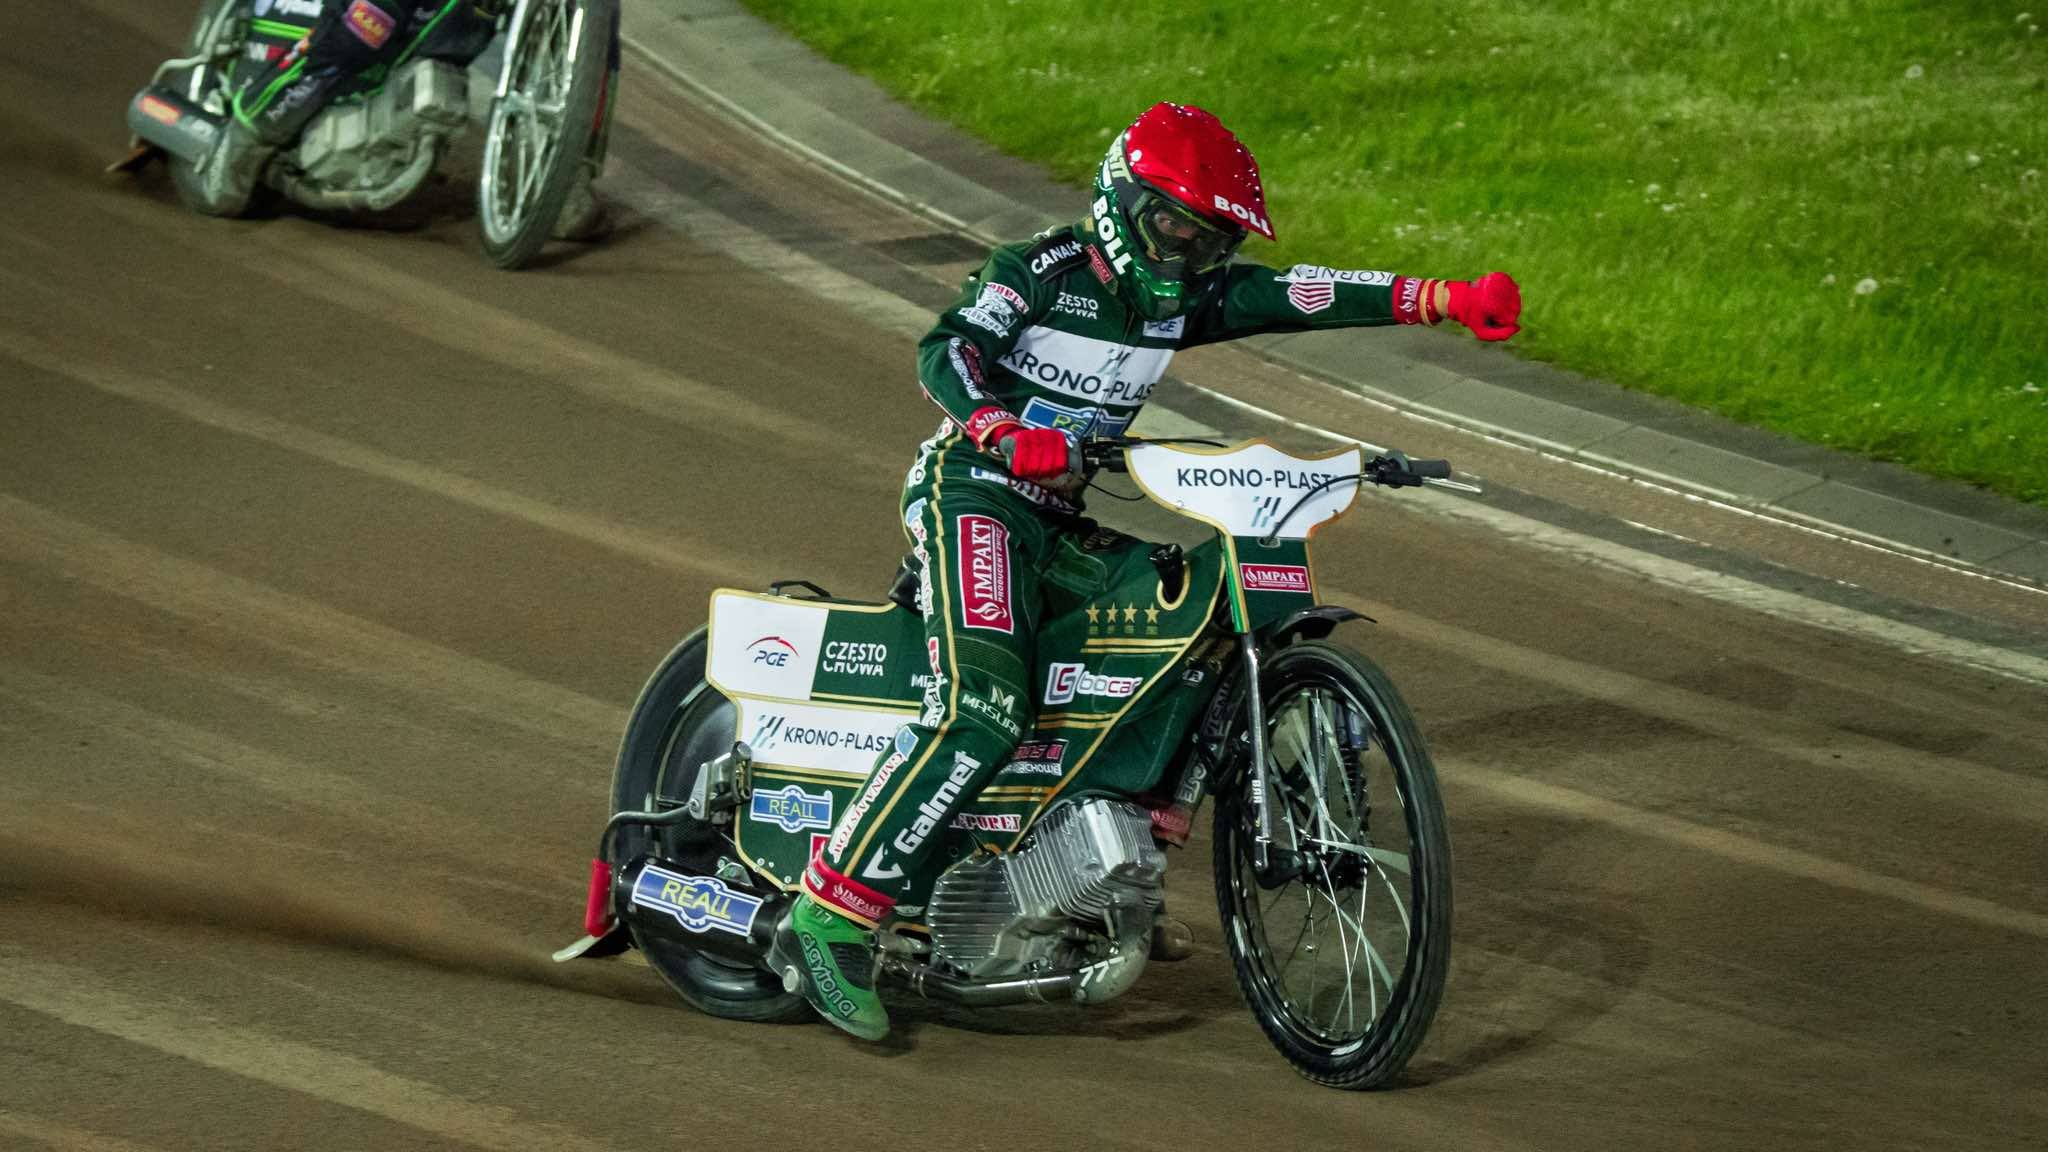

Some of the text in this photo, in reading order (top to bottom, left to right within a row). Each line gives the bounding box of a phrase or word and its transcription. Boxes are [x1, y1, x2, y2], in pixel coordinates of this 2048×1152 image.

[1214, 194, 1272, 236] BOLL
[1093, 195, 1133, 275] BOLL
[1031, 240, 1083, 275] CANAL+
[1177, 468, 1332, 493] KRONO-PLAST
[972, 520, 994, 601] IMPAKT
[1256, 570, 1305, 583] IMPAKT
[754, 650, 789, 667] PGE
[768, 800, 817, 819] REALL
[894, 750, 982, 854] Galmet
[660, 879, 732, 920] REALL
[842, 888, 884, 916] IMPAKT
[802, 934, 857, 1017] daytona
